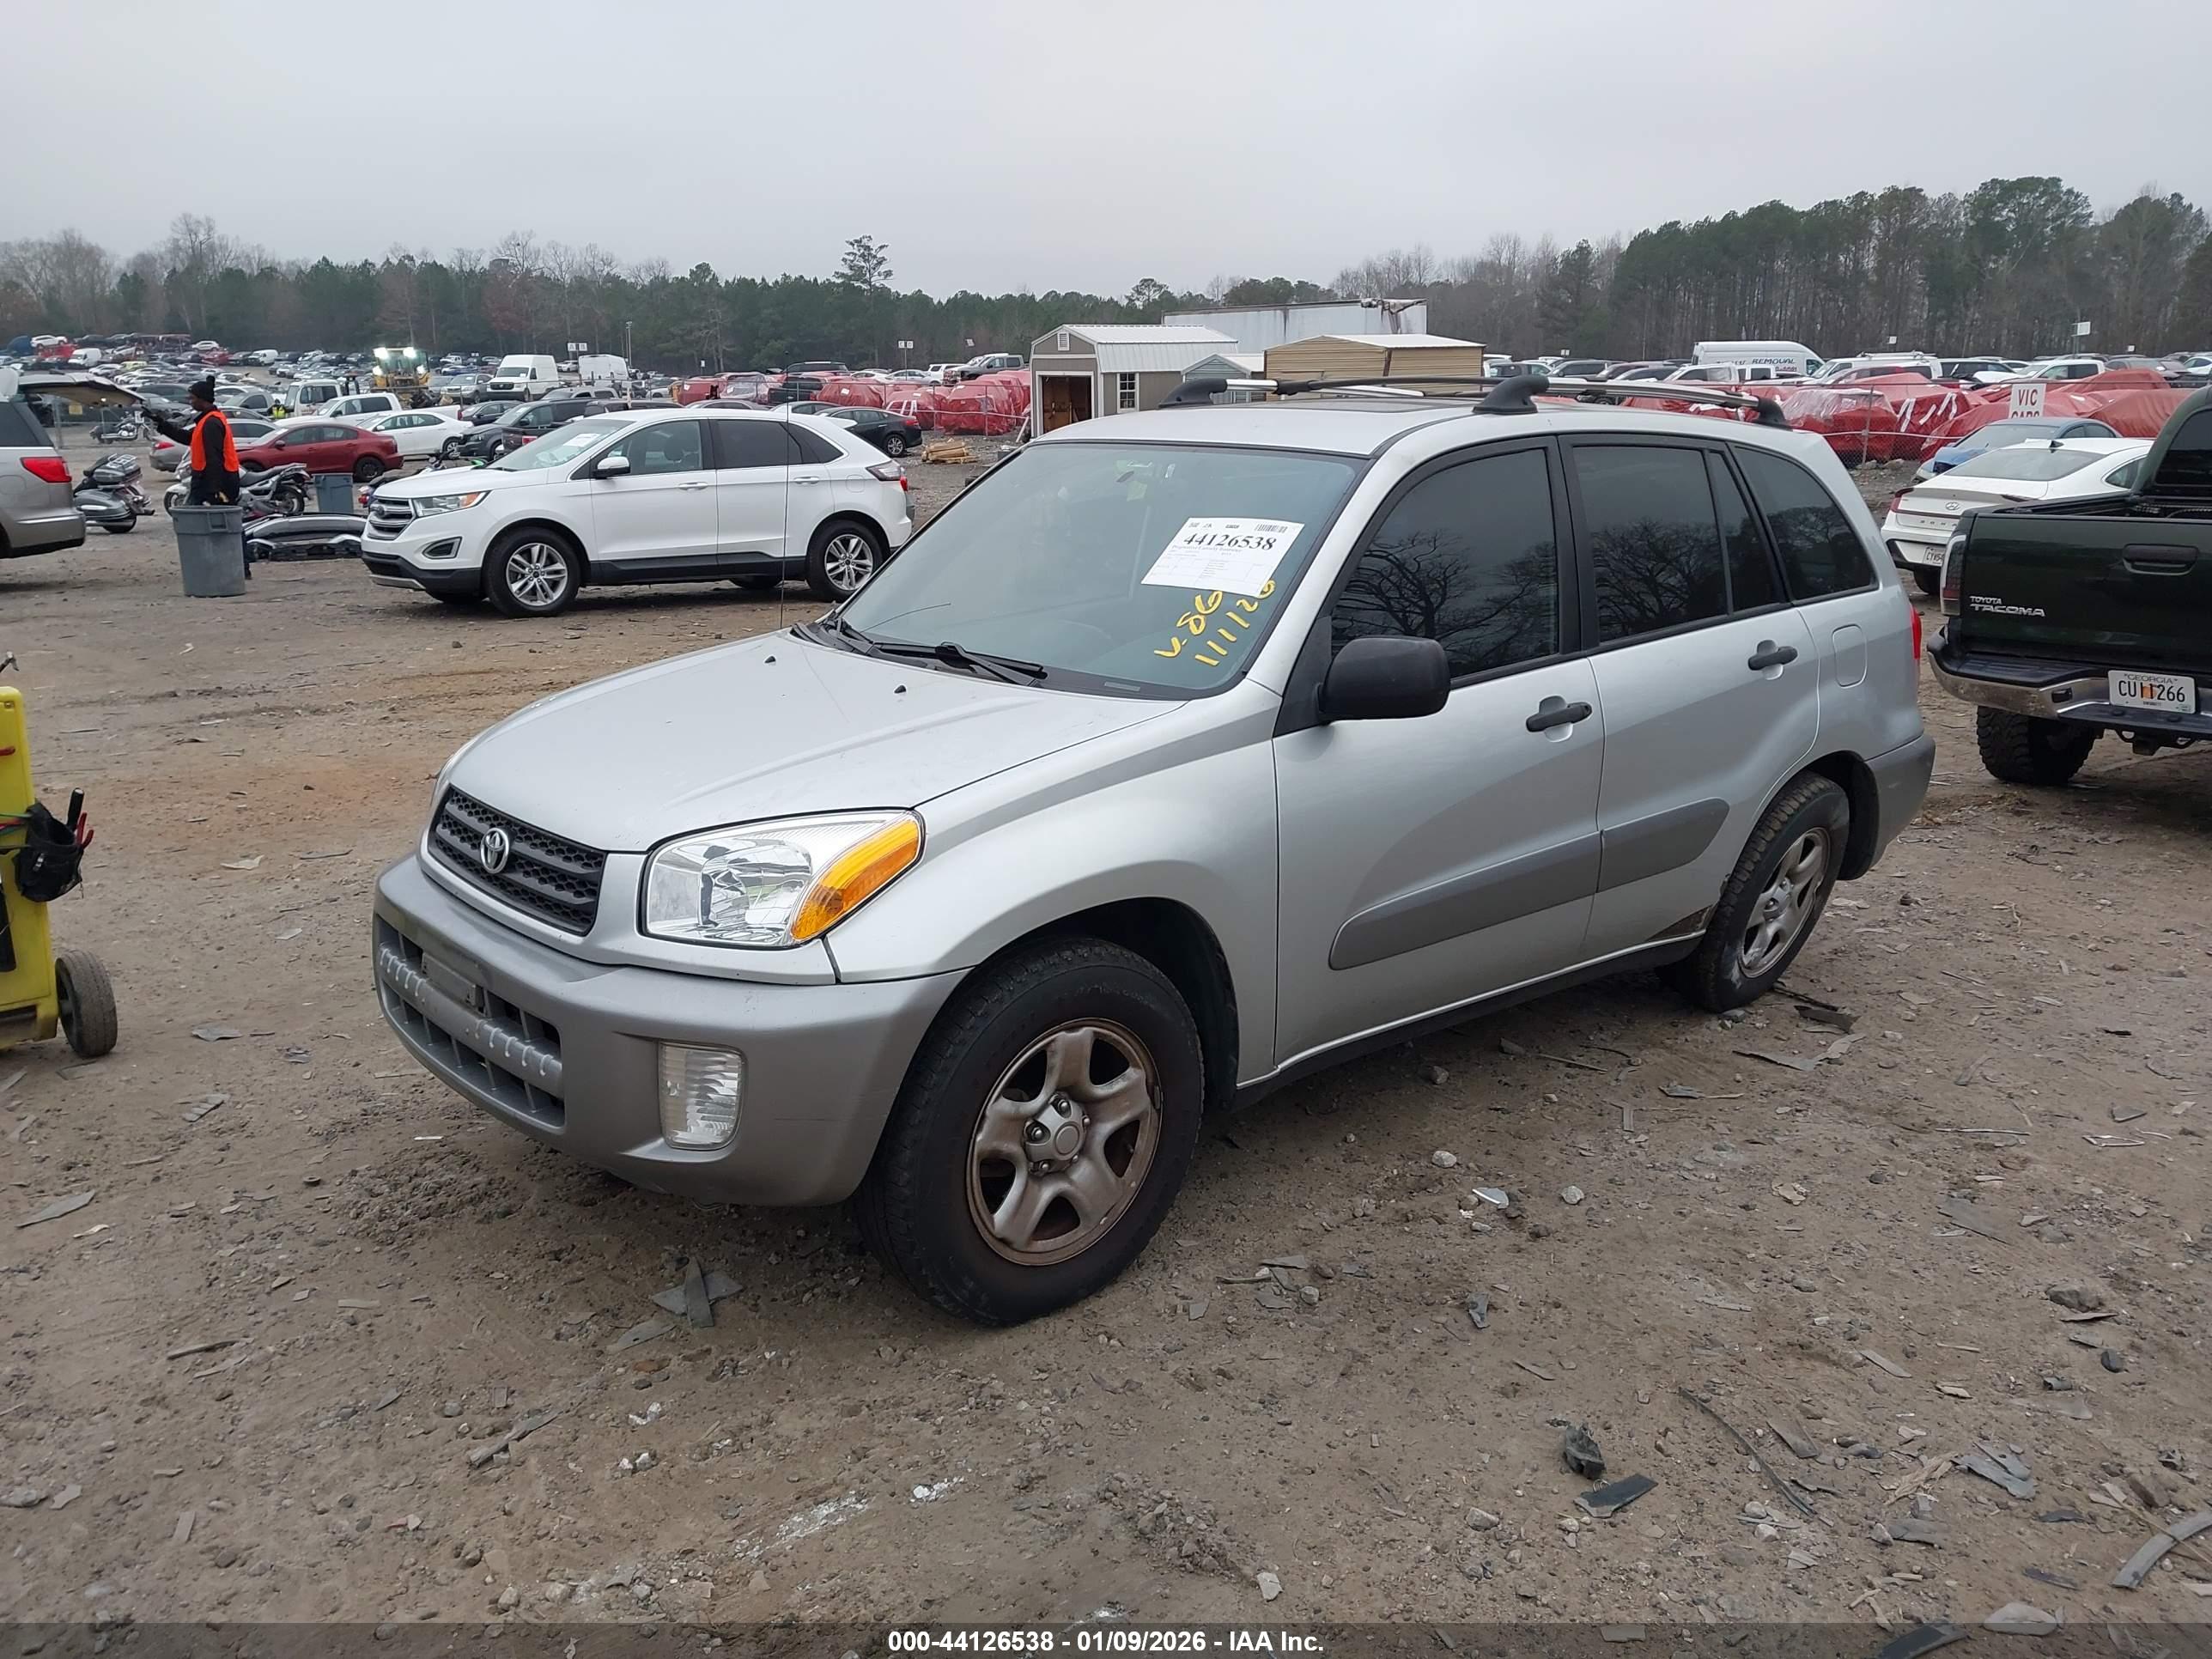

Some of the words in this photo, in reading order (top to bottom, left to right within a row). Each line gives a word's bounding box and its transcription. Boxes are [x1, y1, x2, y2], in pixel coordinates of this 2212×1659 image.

[2018, 388, 2039, 406] VIC
[1183, 532, 1278, 551] 44126538
[1969, 595, 2002, 605] TOYOTA
[1970, 603, 2045, 617] TACOMA
[2127, 673, 2174, 684] GEORGIA
